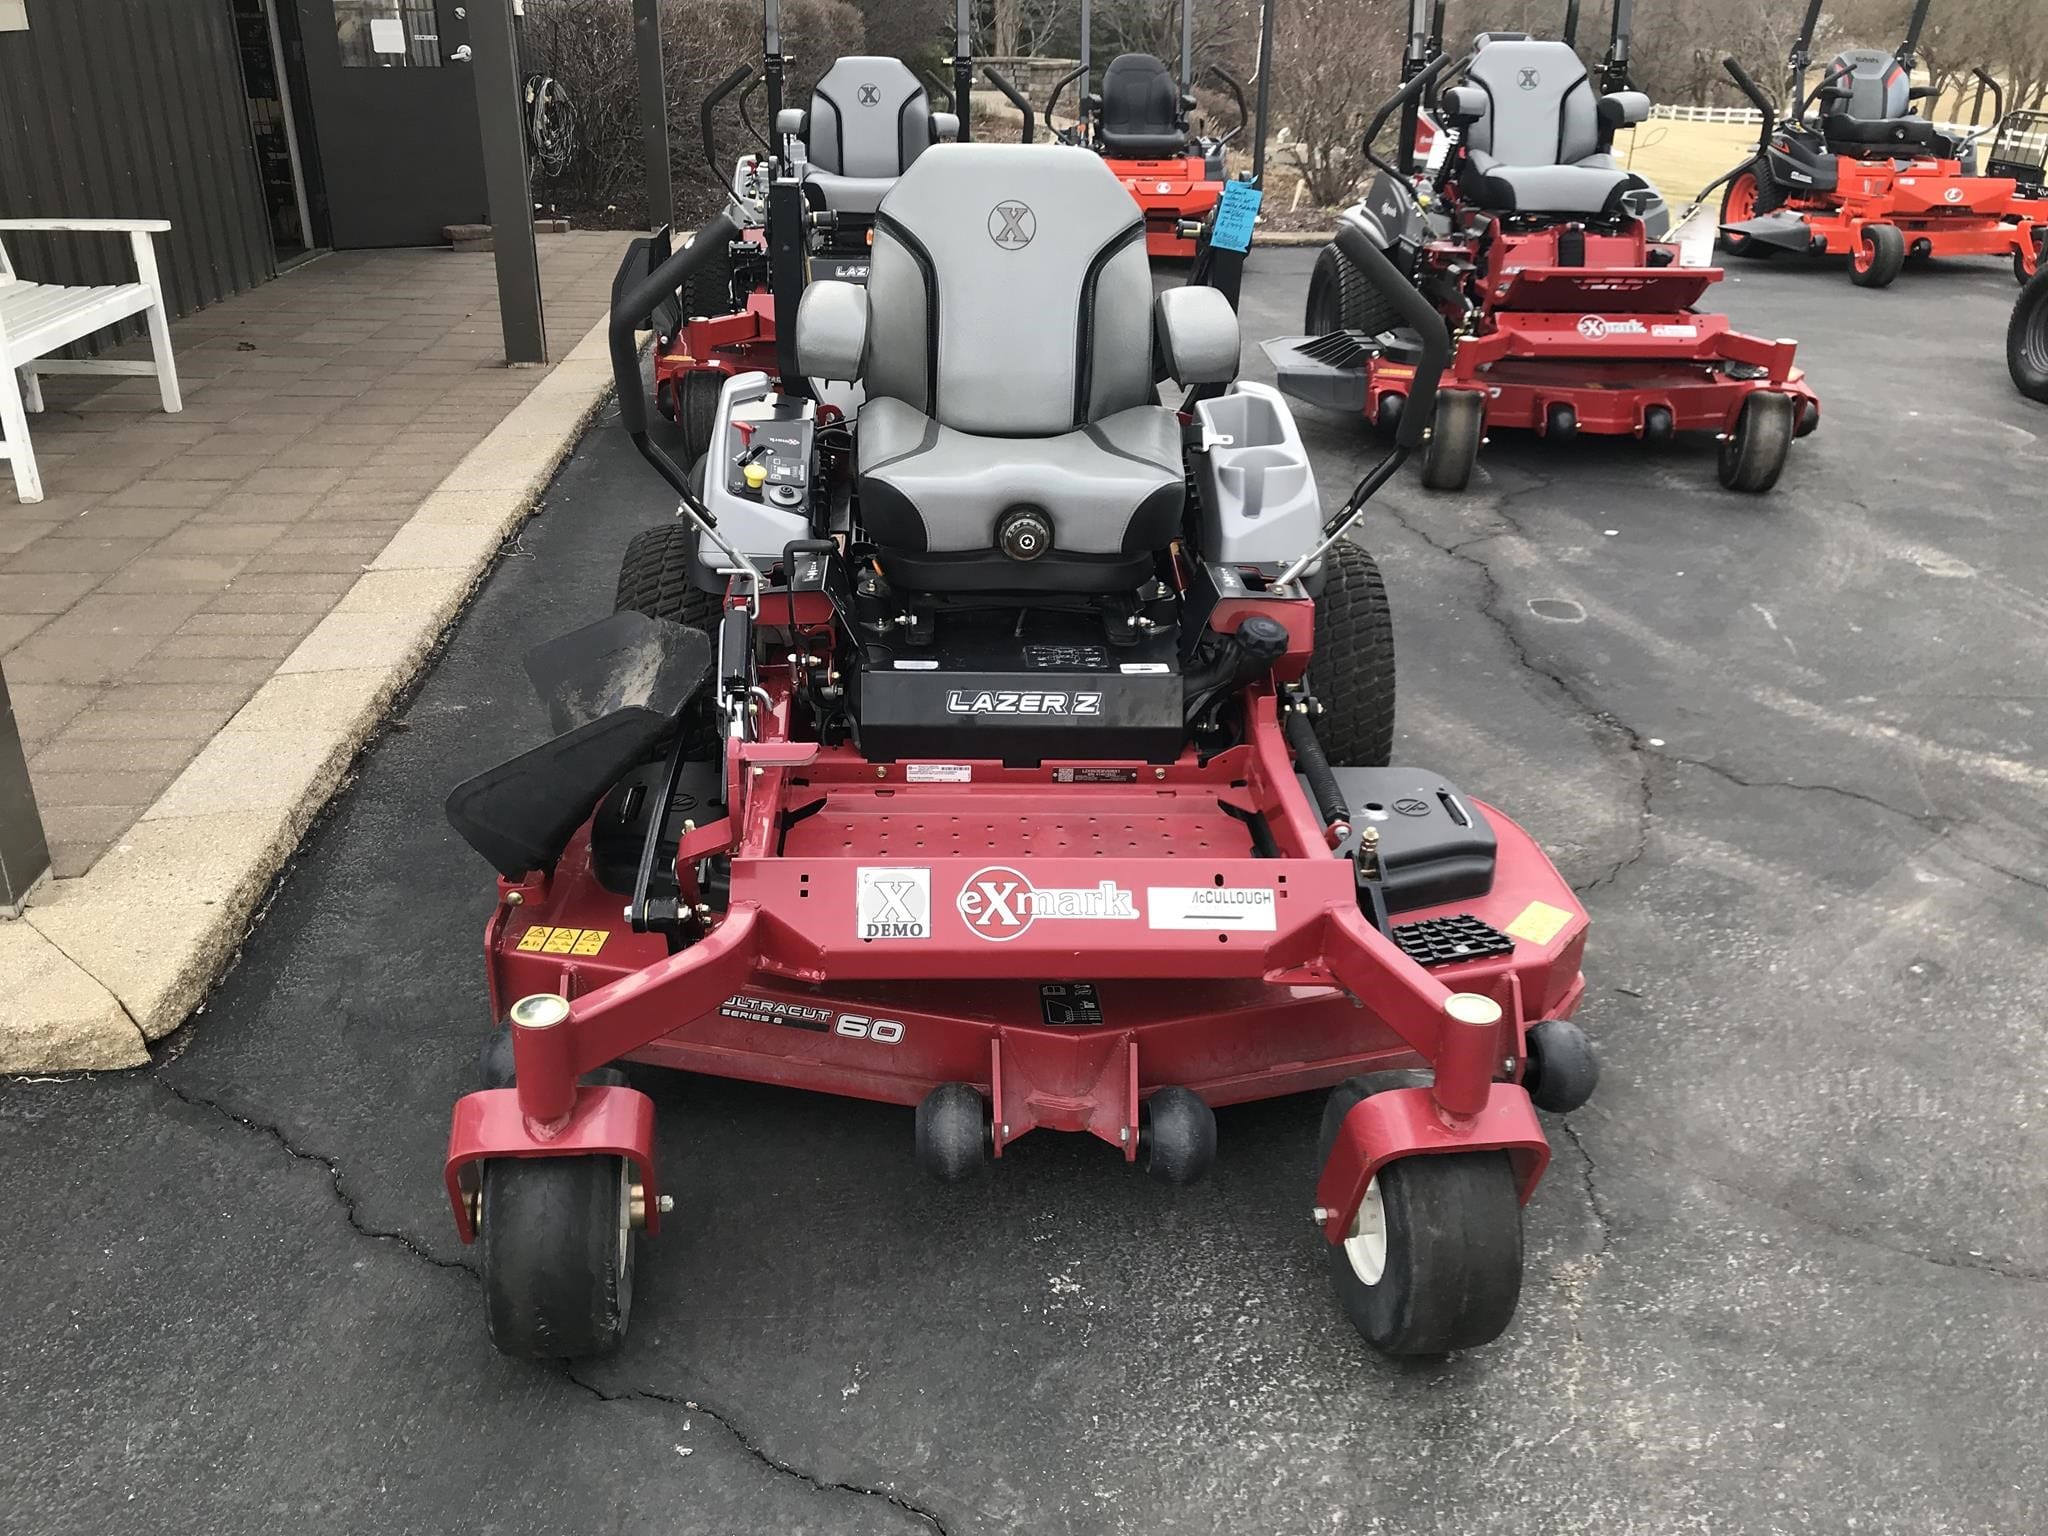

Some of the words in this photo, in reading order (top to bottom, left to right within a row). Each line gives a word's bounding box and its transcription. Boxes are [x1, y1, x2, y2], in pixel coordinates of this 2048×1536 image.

[860, 86, 879, 104] X
[996, 207, 1028, 242] X
[835, 266, 870, 278] LAZ
[948, 691, 1068, 714] LAZER
[1070, 692, 1101, 715] Z
[873, 881, 916, 923] X
[959, 880, 1134, 926] eXmark
[866, 923, 924, 937] DEMO
[722, 1009, 769, 1022] SERIES
[835, 1013, 905, 1044] 60
